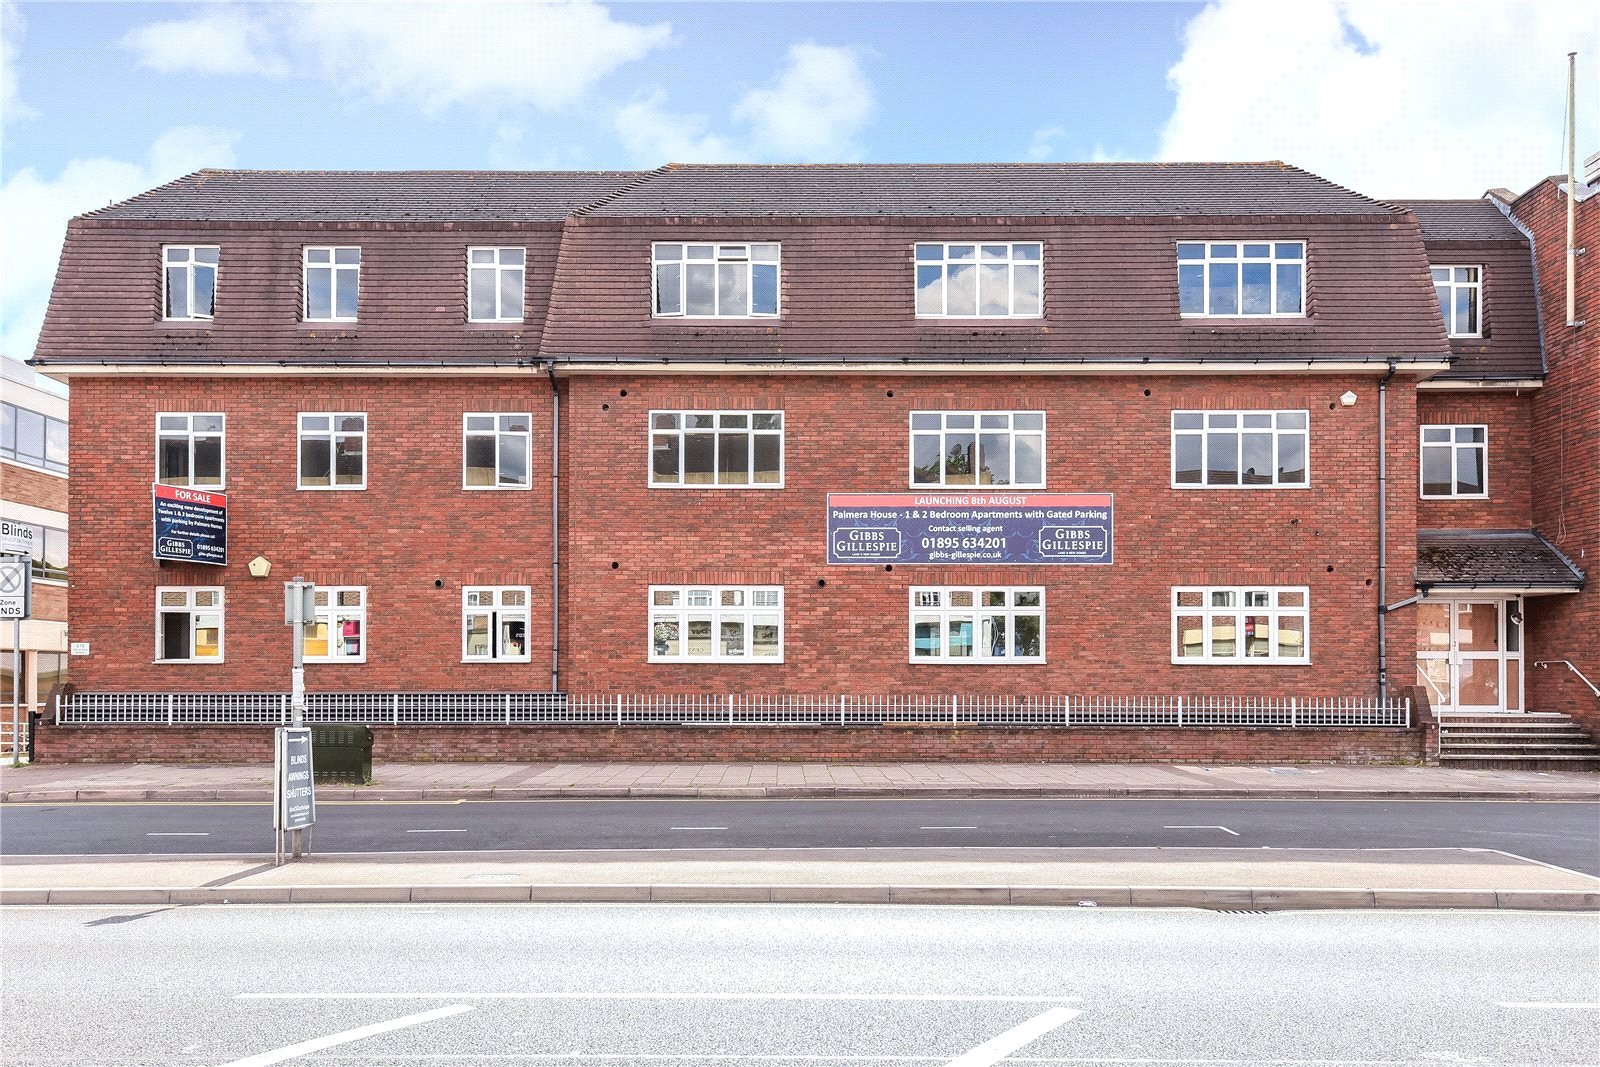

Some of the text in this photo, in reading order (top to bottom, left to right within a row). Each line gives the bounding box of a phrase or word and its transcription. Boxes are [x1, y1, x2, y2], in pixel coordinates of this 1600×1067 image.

[175, 490, 211, 503] FOR SALE
[194, 506, 220, 514] development
[971, 511, 1022, 519] Apartments
[1075, 510, 1107, 520] Parking
[205, 514, 225, 523] apartments
[2, 523, 32, 539] Blinds
[849, 531, 884, 541] GIBBS
[1055, 529, 1090, 539] GIBBS
[837, 541, 897, 552] GILLESPIE
[922, 538, 1005, 548] 01895 634201
[1042, 539, 1103, 550] GILLESPIE
[160, 546, 191, 554] GILLESPIE
[929, 551, 1002, 560] gibbs-gillespie.co.uk
[290, 754, 307, 765] BLINDS
[288, 771, 309, 782] AWNINGS
[287, 787, 311, 799] SHUTTERS
